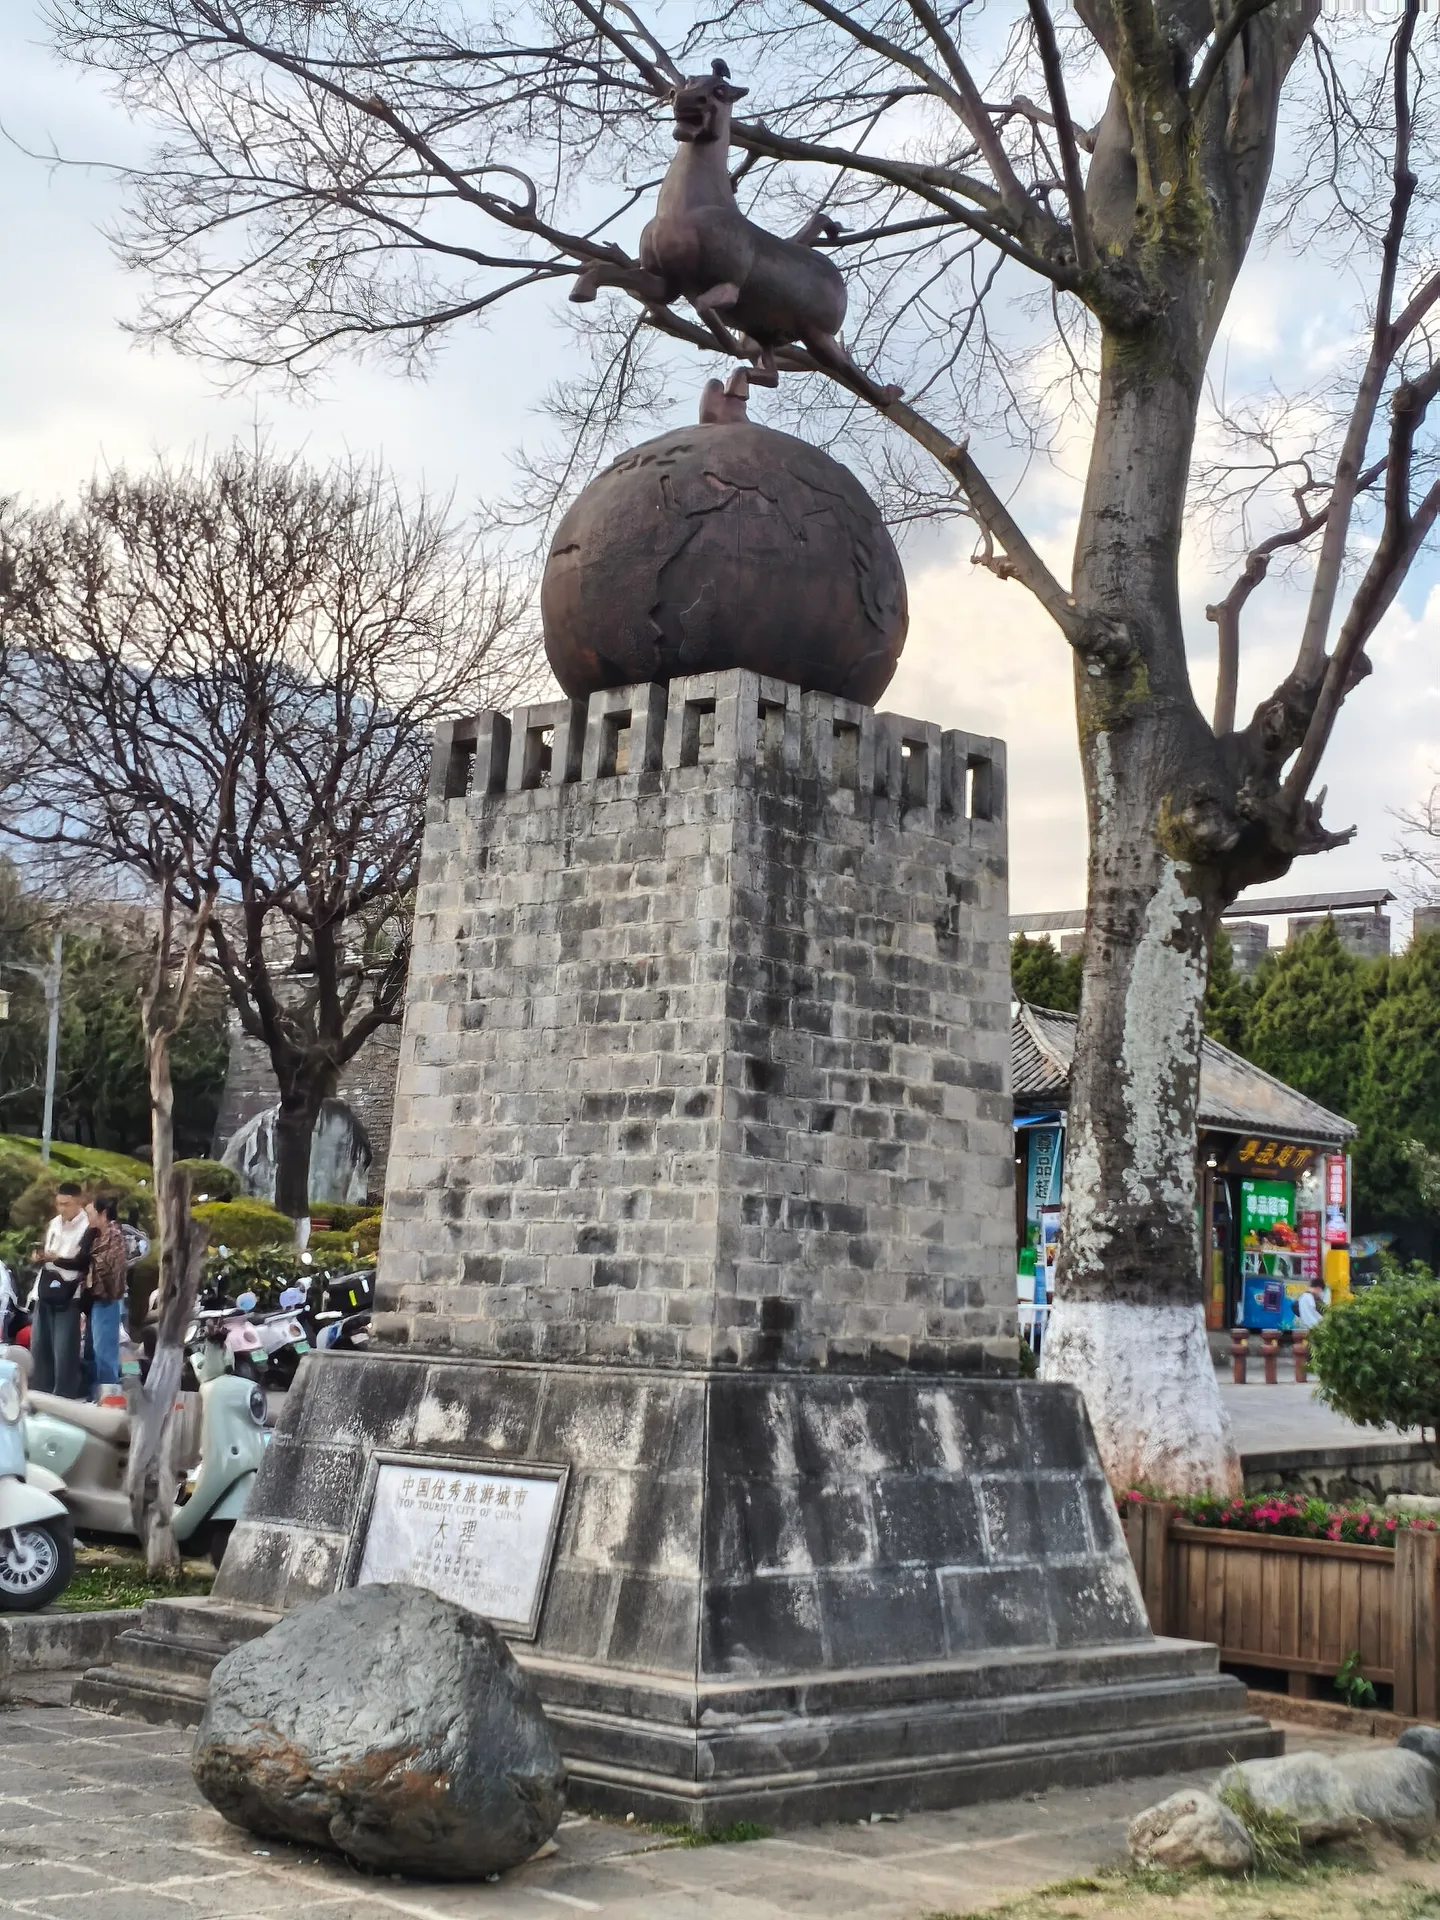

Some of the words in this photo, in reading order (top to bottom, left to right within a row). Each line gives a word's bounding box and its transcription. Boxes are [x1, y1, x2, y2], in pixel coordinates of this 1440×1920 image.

[403, 1474, 528, 1509] 中国优秀旅游城市
[400, 1498, 414, 1508] TOP
[419, 1500, 453, 1514] TOURIST
[456, 1505, 476, 1517] CITY
[480, 1507, 491, 1517] OF
[495, 1509, 522, 1522] CHINA
[431, 1515, 477, 1543] 大理
